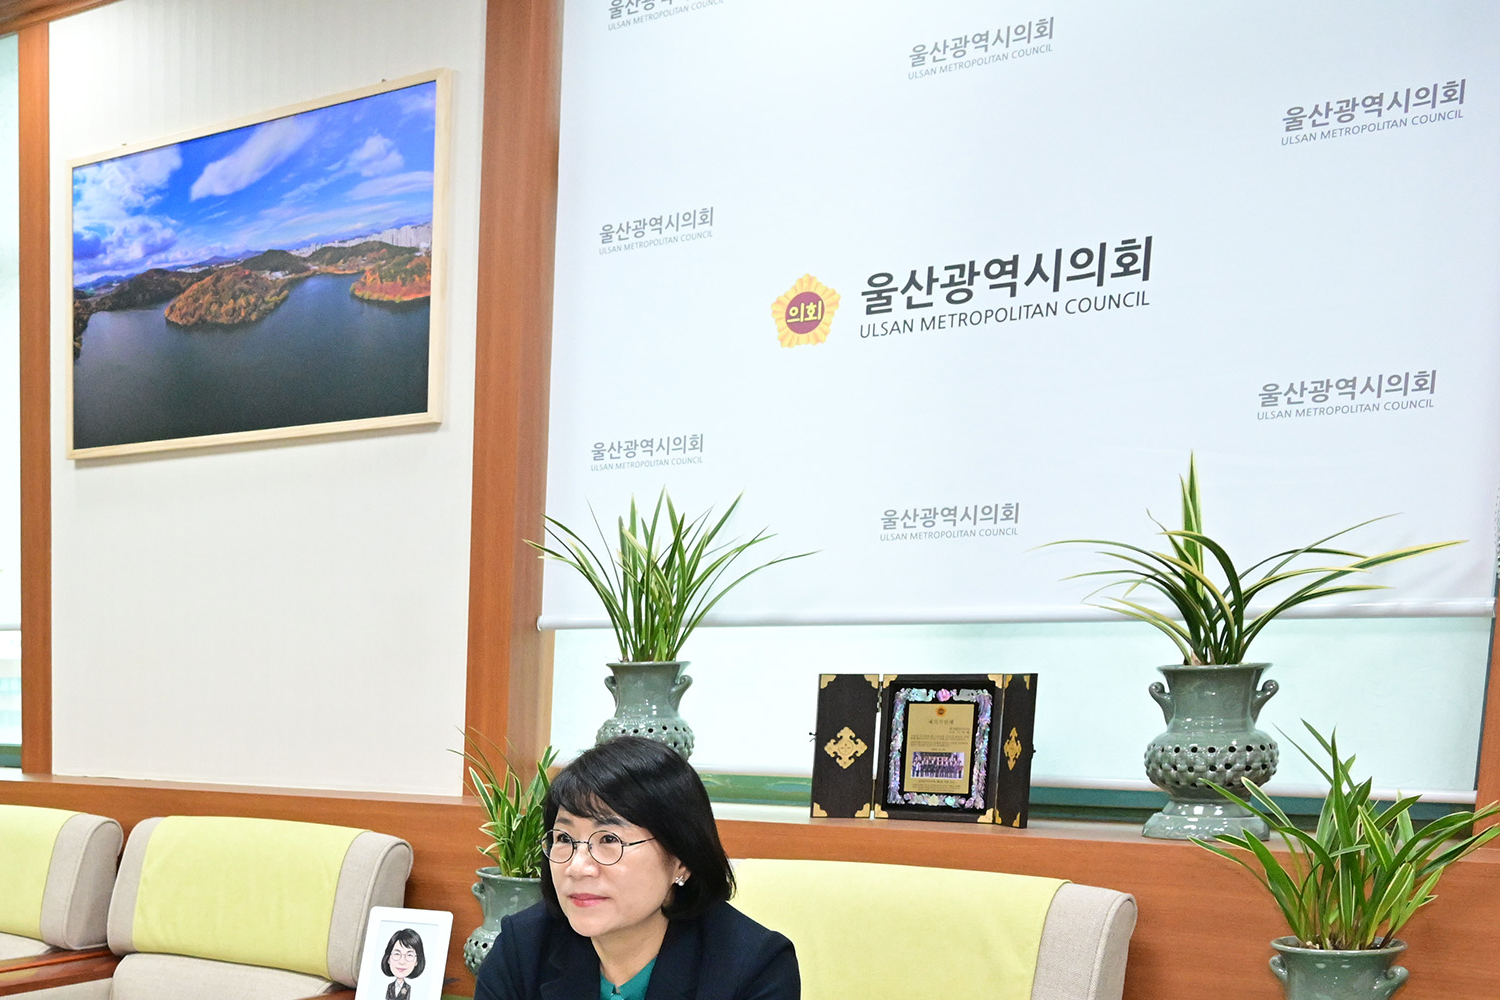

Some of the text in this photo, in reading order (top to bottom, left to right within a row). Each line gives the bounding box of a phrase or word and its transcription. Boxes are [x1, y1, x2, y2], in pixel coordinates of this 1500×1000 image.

[909, 16, 1054, 68] 울산광역시의회
[1282, 78, 1466, 132] 울산광역시의회
[1281, 110, 1464, 146] ULSAN METROPOLITAN COUNCIL
[599, 206, 714, 244] 울산광역시의회
[860, 235, 1153, 316] 울산광역시의회
[787, 300, 822, 322] 의회
[859, 291, 1151, 339] ULSAN METROPOLITAN COUNCIL
[1258, 370, 1437, 407] 울산광역시의회
[1257, 399, 1435, 420] ULSAN METROPOLITAN COUNCIL
[591, 433, 704, 461] 울산광역시의회
[880, 502, 1019, 530] 울산광역시의회
